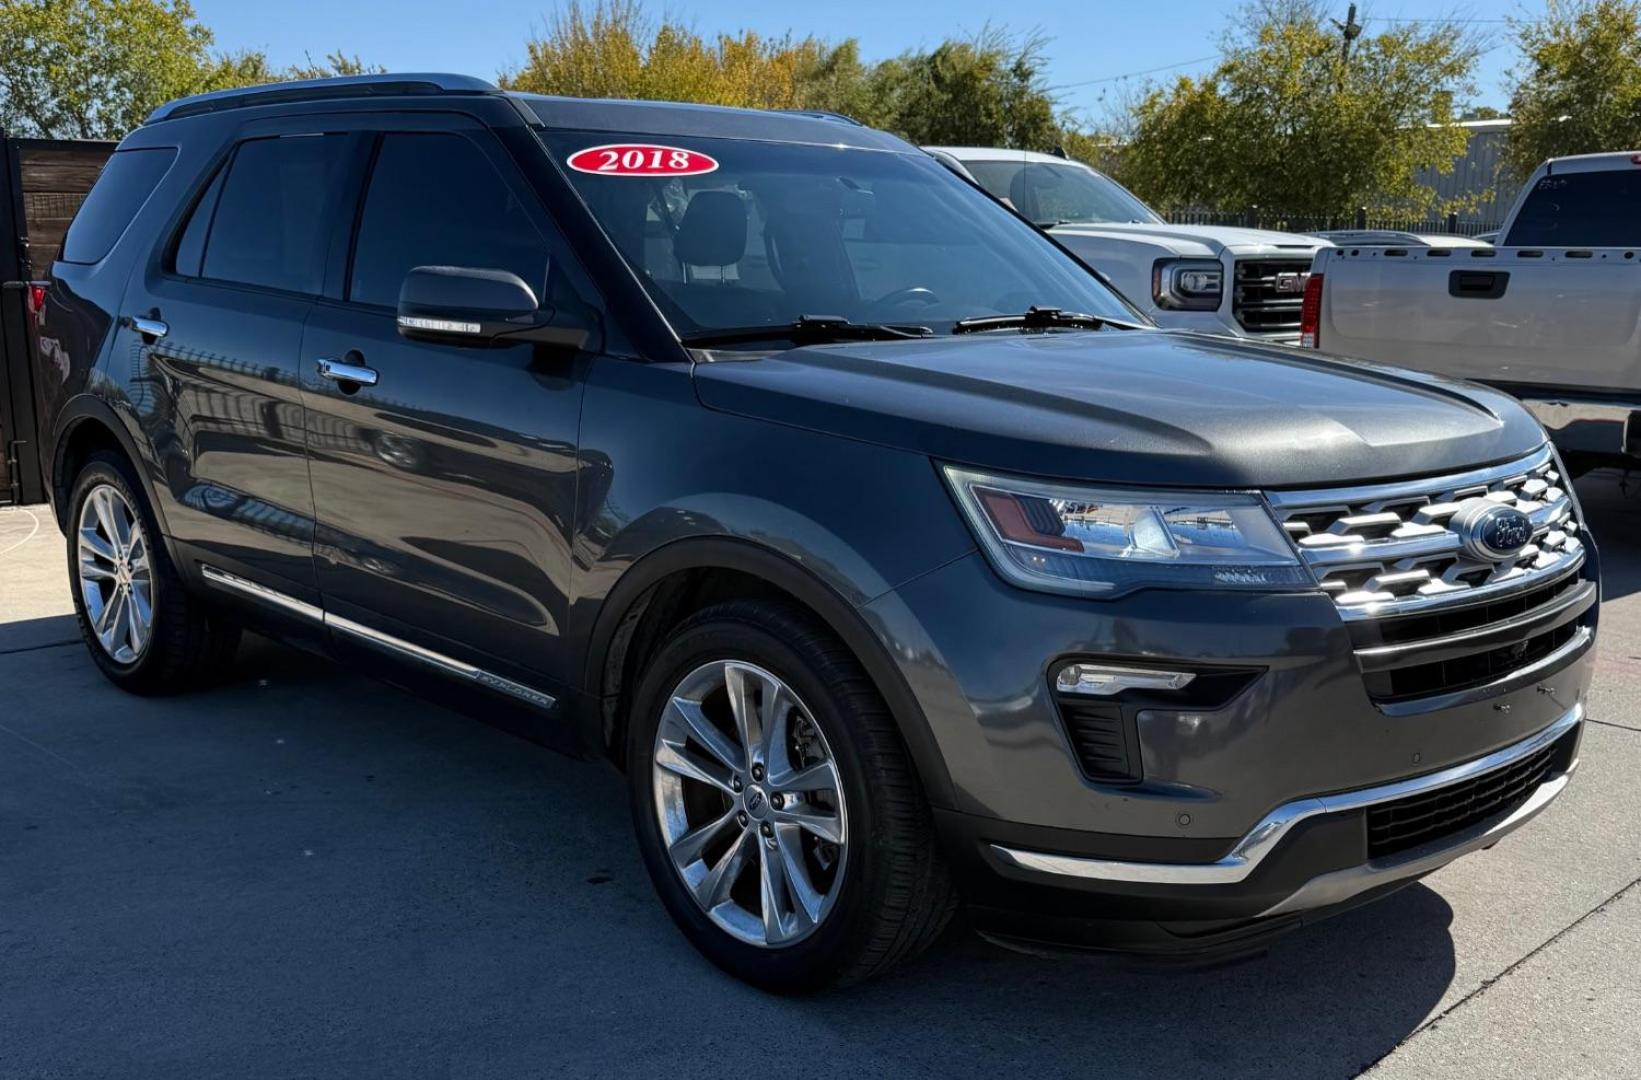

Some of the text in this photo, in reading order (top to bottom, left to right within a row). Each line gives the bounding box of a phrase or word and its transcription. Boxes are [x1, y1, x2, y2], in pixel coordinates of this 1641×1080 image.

[598, 150, 689, 171] 2018
[1276, 272, 1311, 293] GM
[1496, 515, 1527, 547] Ford
